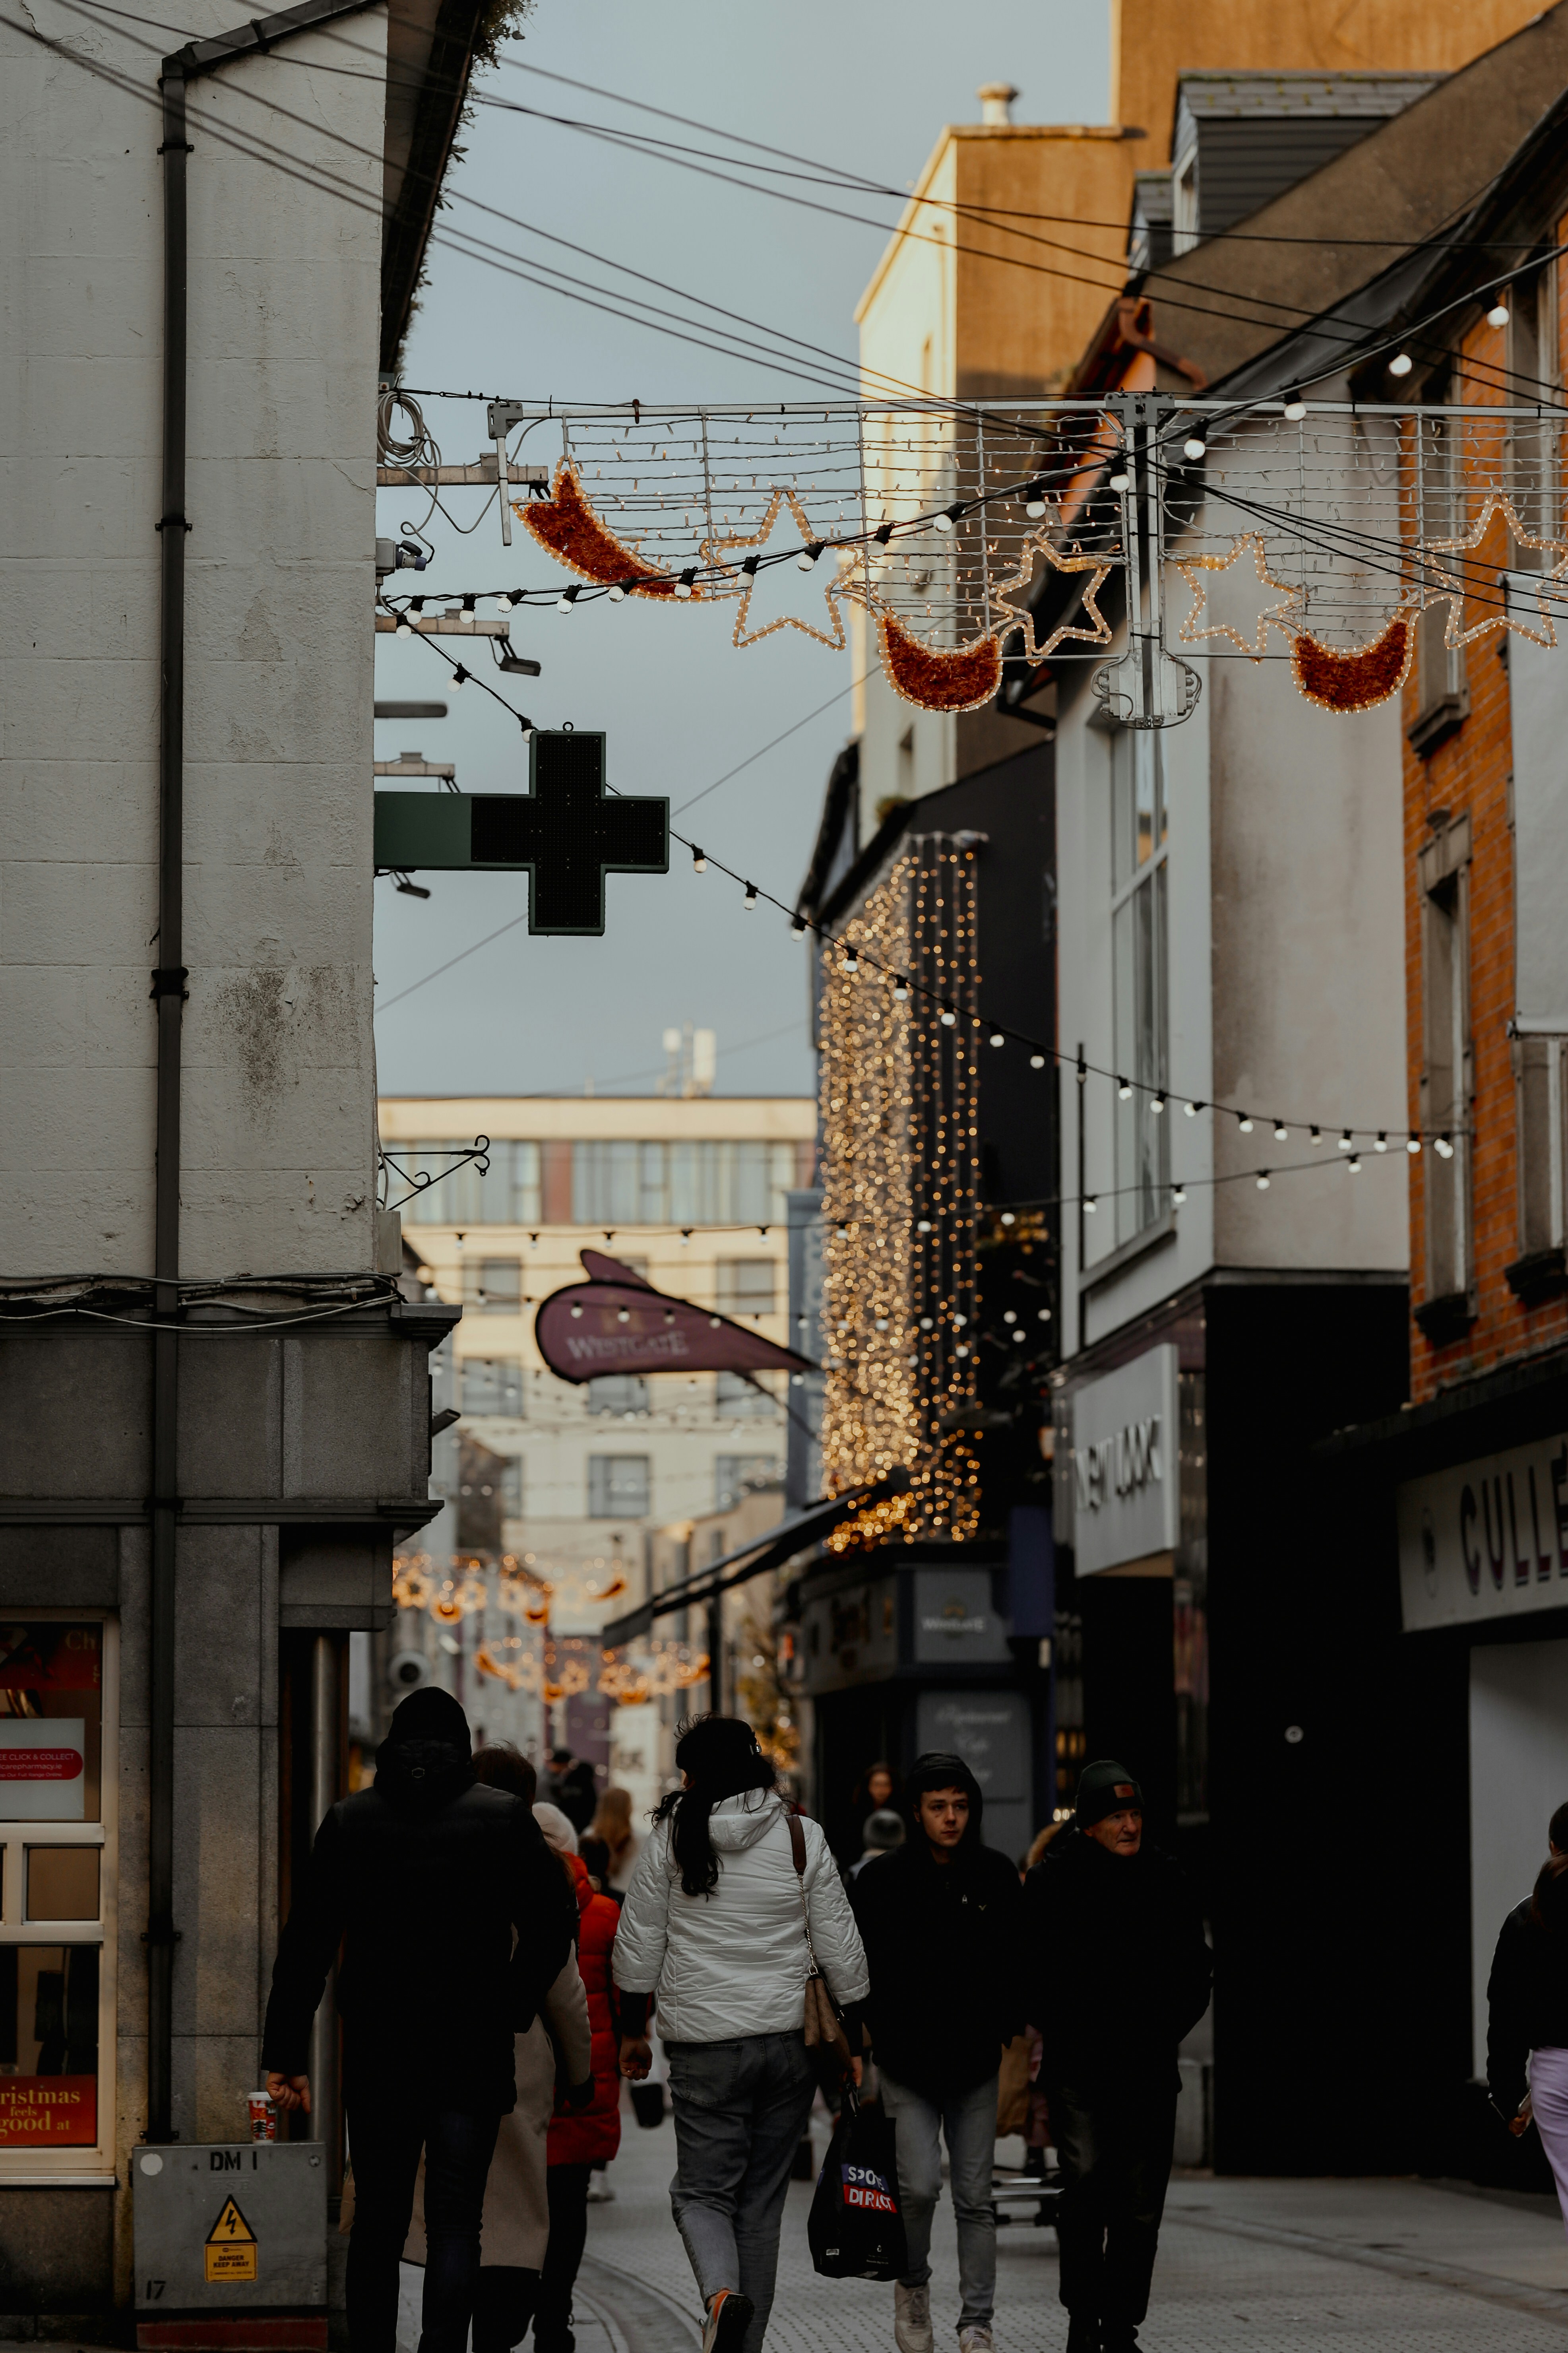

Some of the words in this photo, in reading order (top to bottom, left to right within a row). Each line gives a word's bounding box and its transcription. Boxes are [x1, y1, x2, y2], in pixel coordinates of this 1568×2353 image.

[0, 2086, 81, 2105] ristmas
[10, 2106, 38, 2117] feels
[56, 2120, 70, 2131] at
[210, 2151, 240, 2171] DM
[146, 2280, 166, 2300] 17
